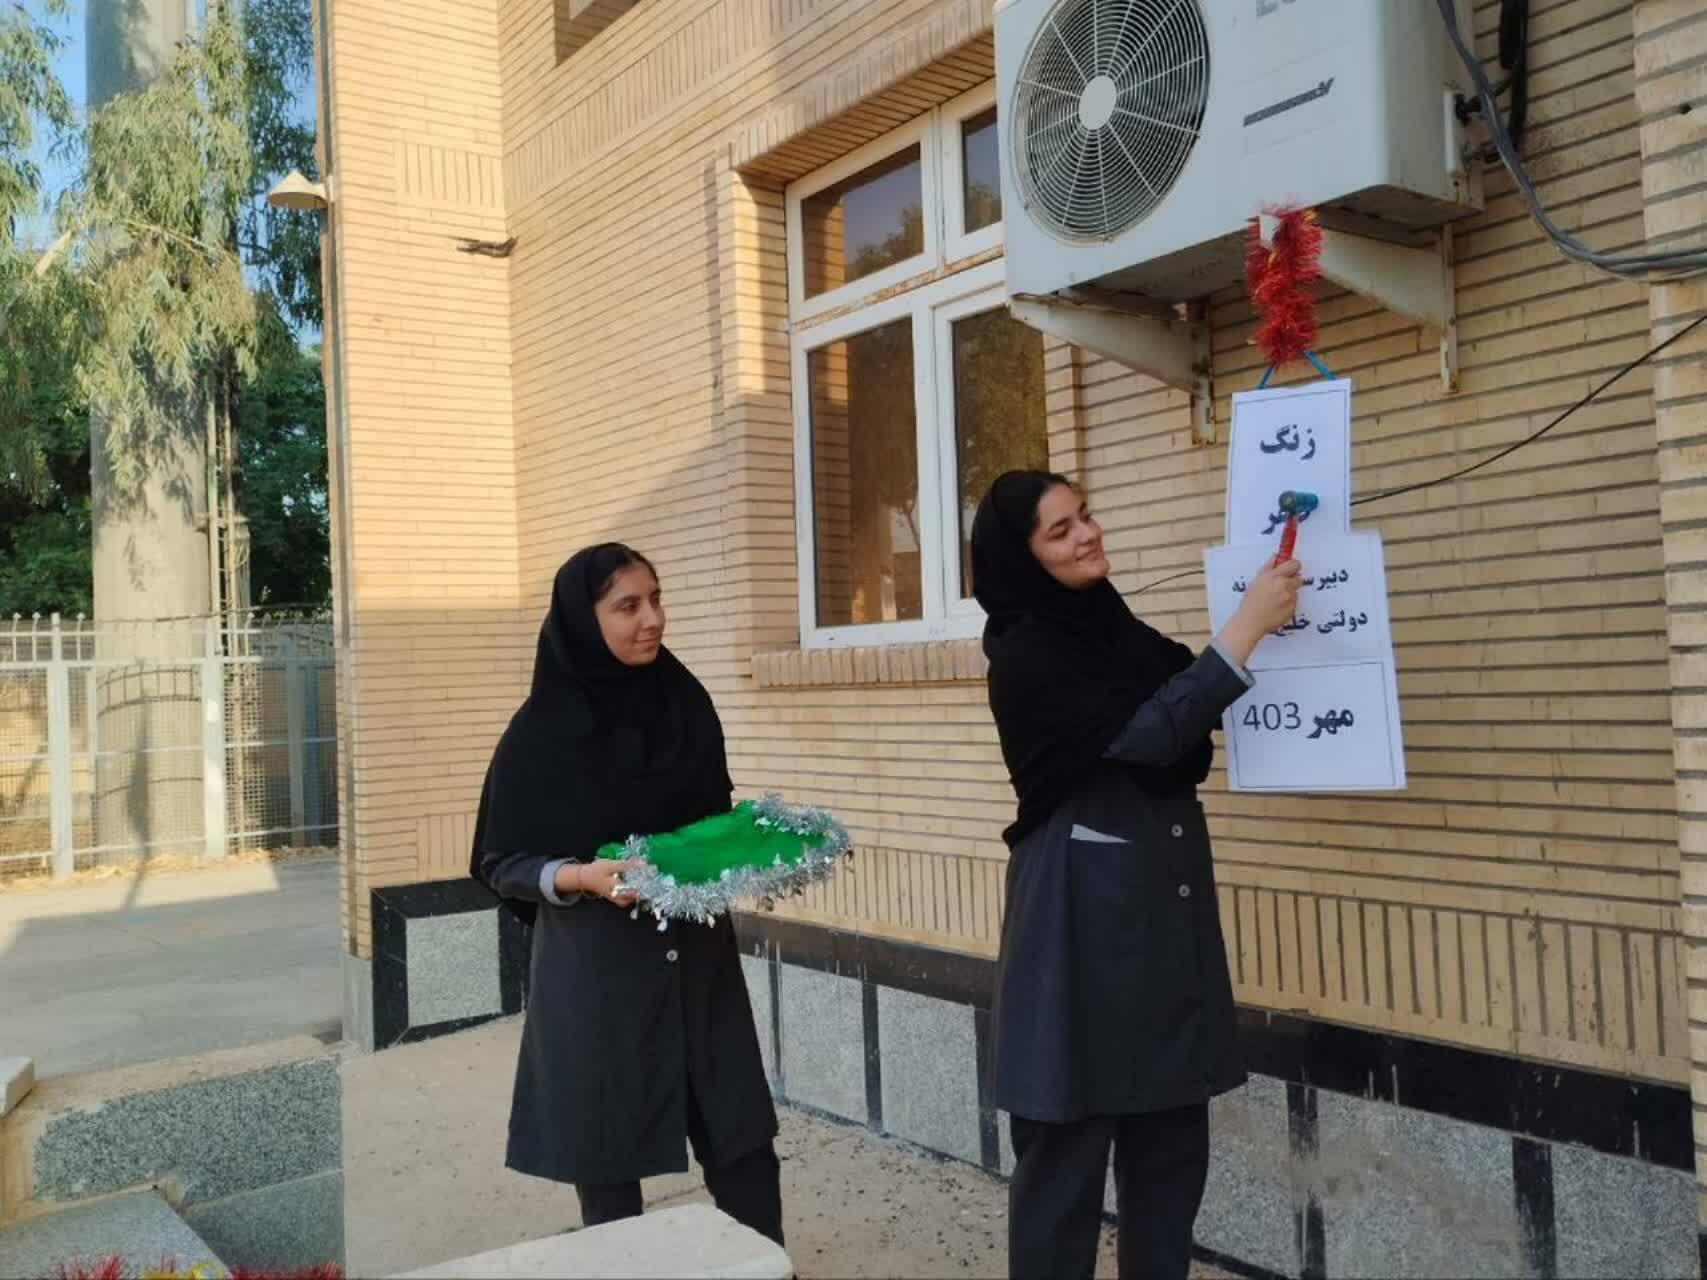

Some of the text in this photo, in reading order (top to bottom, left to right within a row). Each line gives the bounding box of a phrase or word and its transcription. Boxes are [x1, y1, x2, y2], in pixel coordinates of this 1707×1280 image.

[1260, 424, 1315, 460] زنگ
[1317, 609, 1368, 634] دولتی
[1243, 702, 1354, 739] مهر 403
